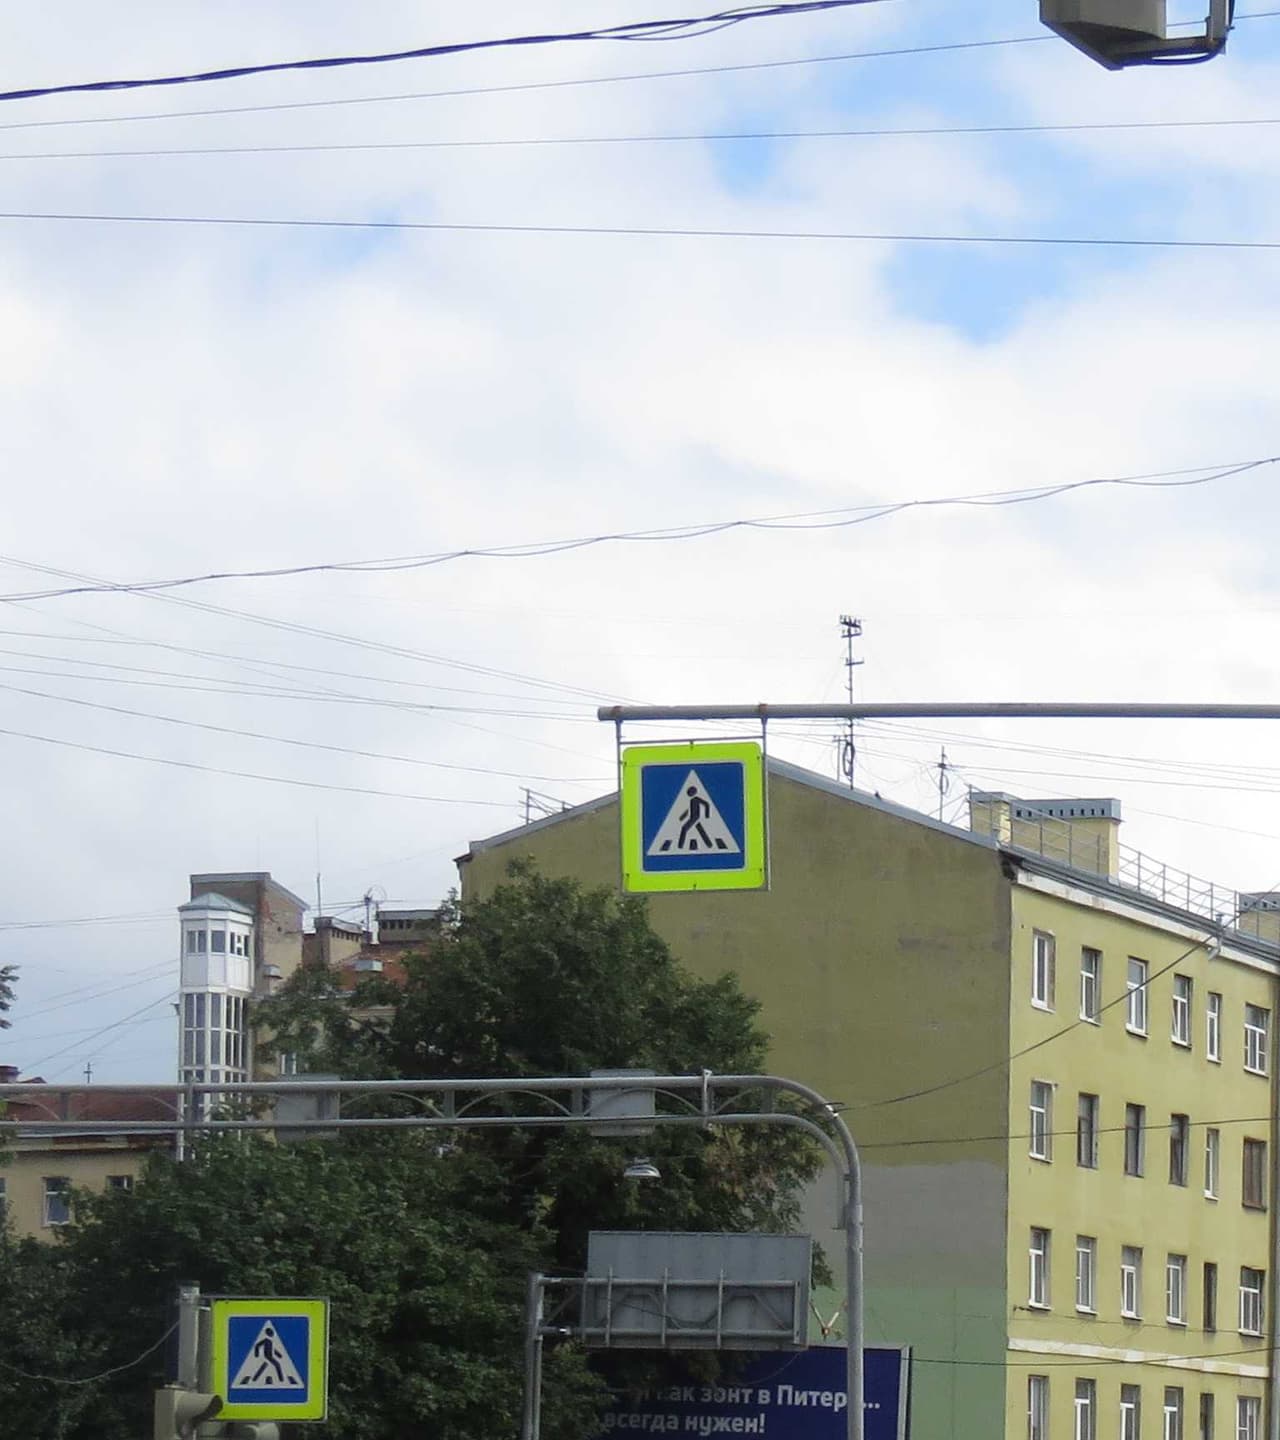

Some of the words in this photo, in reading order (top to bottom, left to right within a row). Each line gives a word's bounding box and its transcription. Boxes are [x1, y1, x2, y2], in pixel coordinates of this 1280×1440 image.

[701, 1386, 753, 1405] зонт
[757, 1387, 770, 1405] в
[603, 1411, 679, 1433] всегда
[685, 1413, 765, 1436] нужен!
